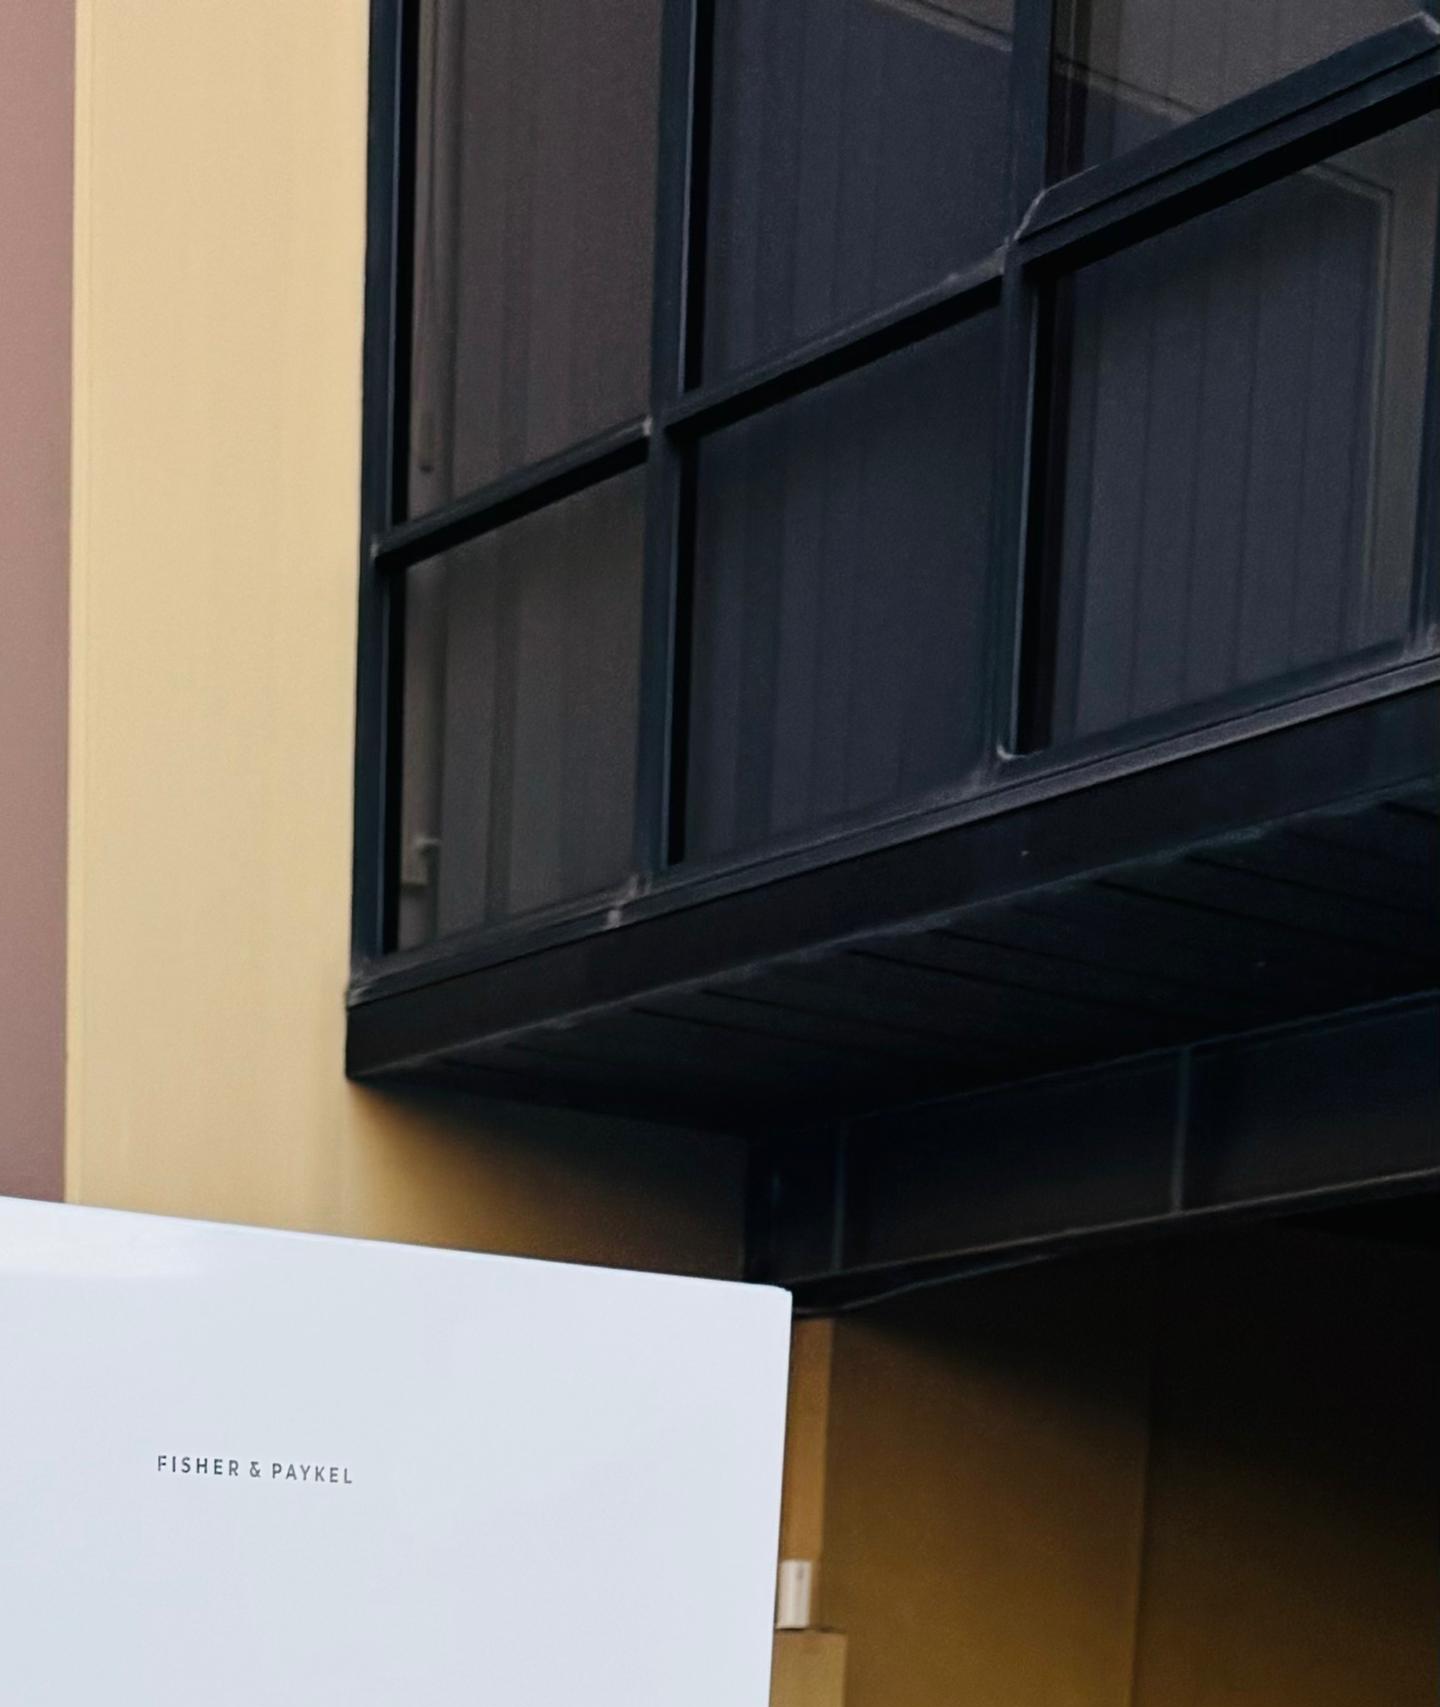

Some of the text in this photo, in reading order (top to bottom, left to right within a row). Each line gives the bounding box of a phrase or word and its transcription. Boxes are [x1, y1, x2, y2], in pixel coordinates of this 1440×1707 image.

[157, 1455, 353, 1484] FISHER & PAYKEL
